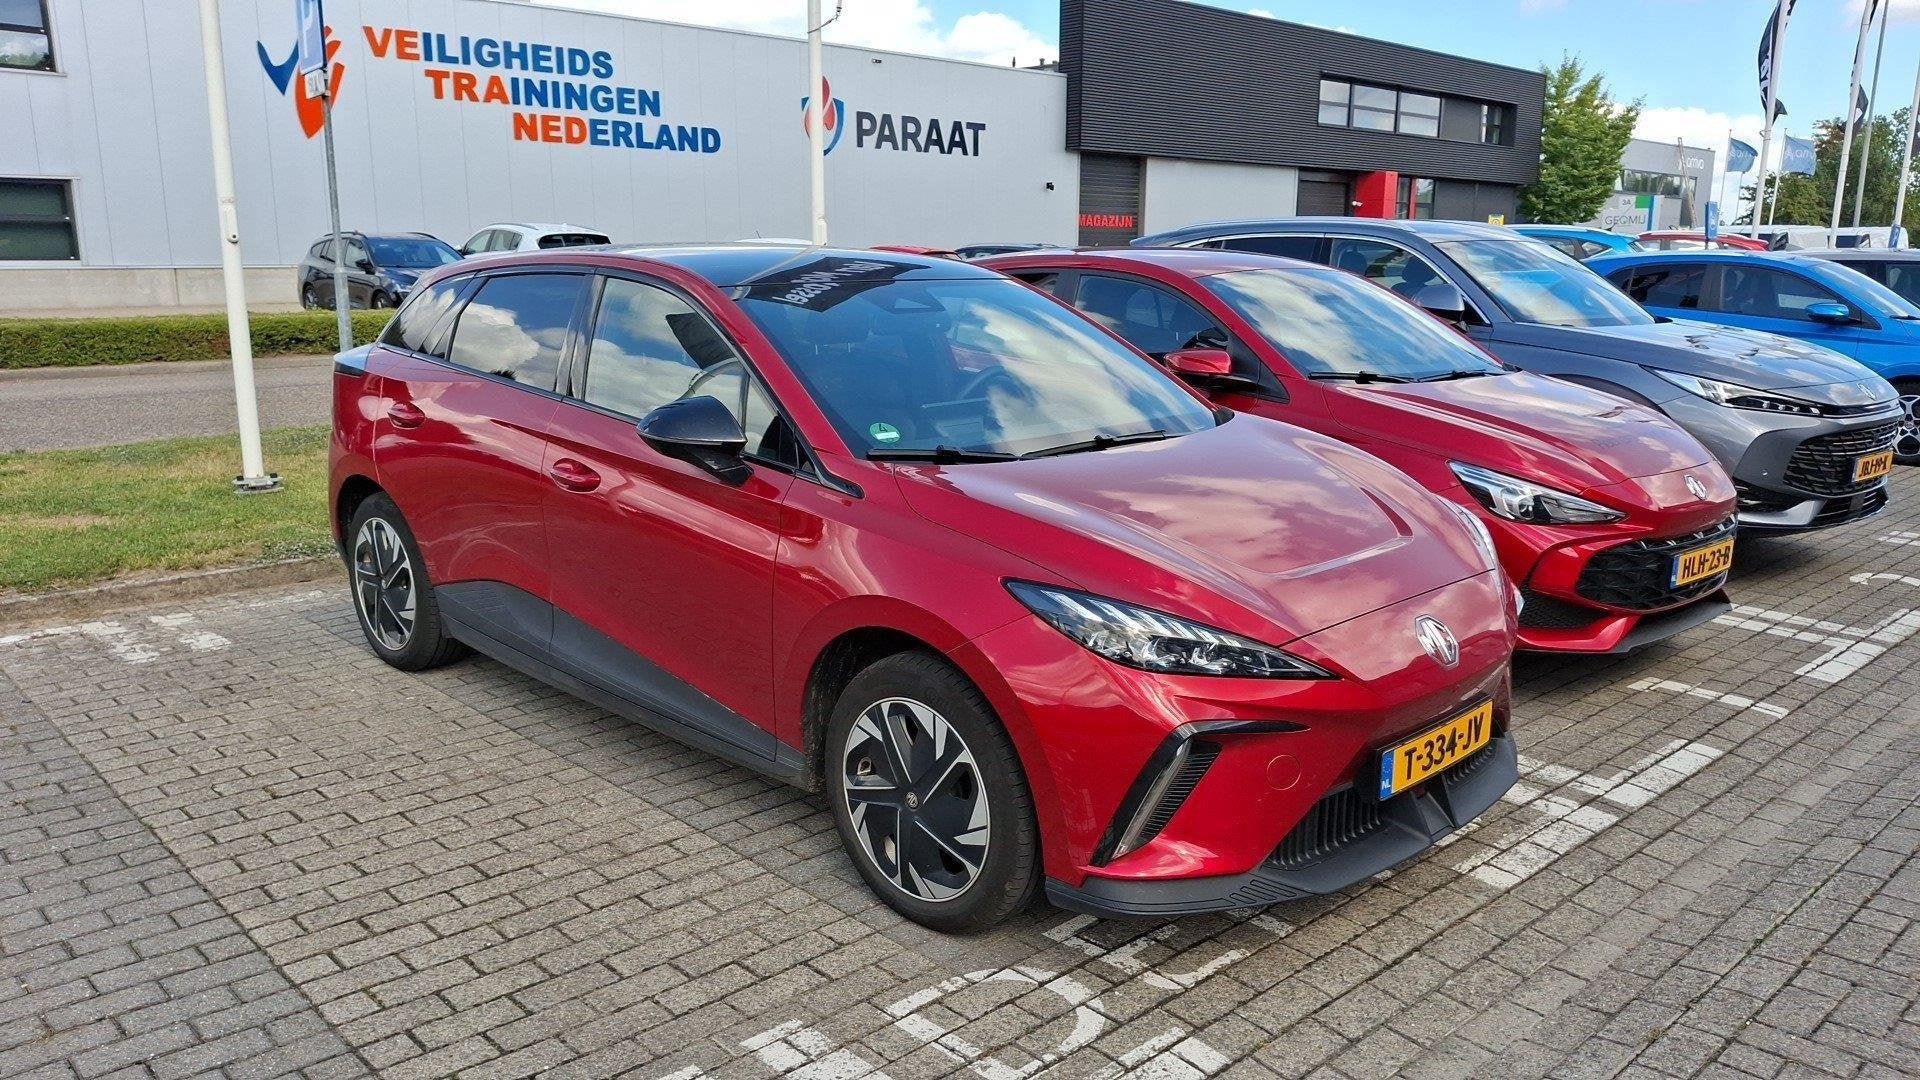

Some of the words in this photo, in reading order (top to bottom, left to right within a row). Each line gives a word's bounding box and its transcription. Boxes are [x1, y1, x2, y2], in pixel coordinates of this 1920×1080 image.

[362, 25, 614, 79] VEILIGHEIDS
[424, 69, 661, 117] TRAININGEN
[513, 112, 721, 154] NEDERLAND
[856, 111, 986, 157] PARAAT
[1682, 546, 1731, 579] HLH-23-B
[1404, 712, 1485, 780] T-334-JV
[1381, 780, 1392, 790] NL
